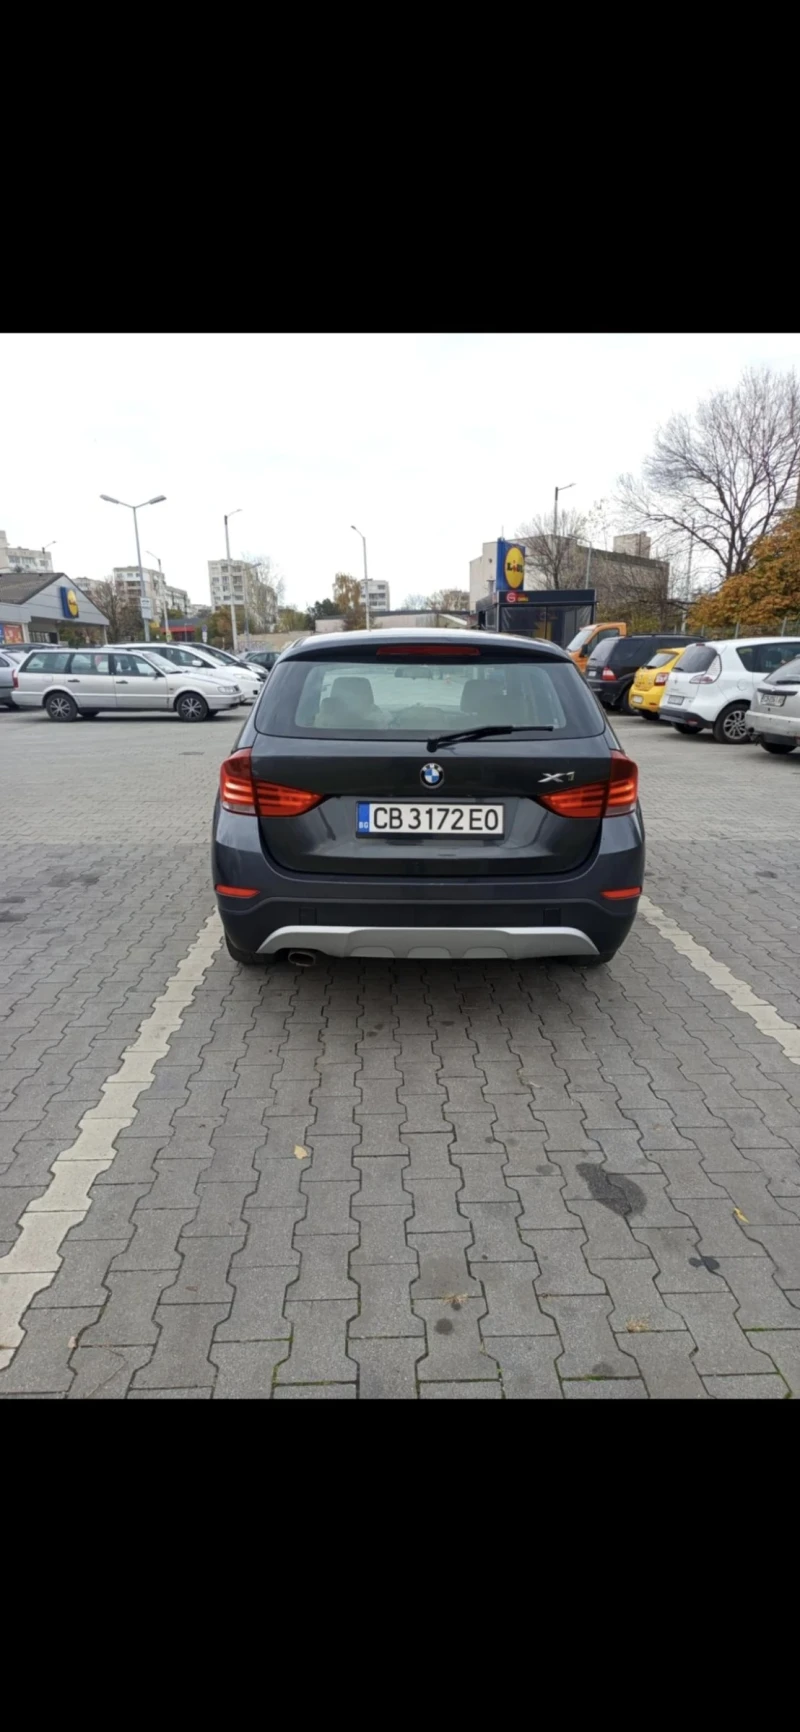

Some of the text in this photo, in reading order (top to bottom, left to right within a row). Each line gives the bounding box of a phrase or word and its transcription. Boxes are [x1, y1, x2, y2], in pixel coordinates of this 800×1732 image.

[537, 771, 575, 783] X1
[373, 807, 403, 830] CB
[408, 807, 464, 831] 3172
